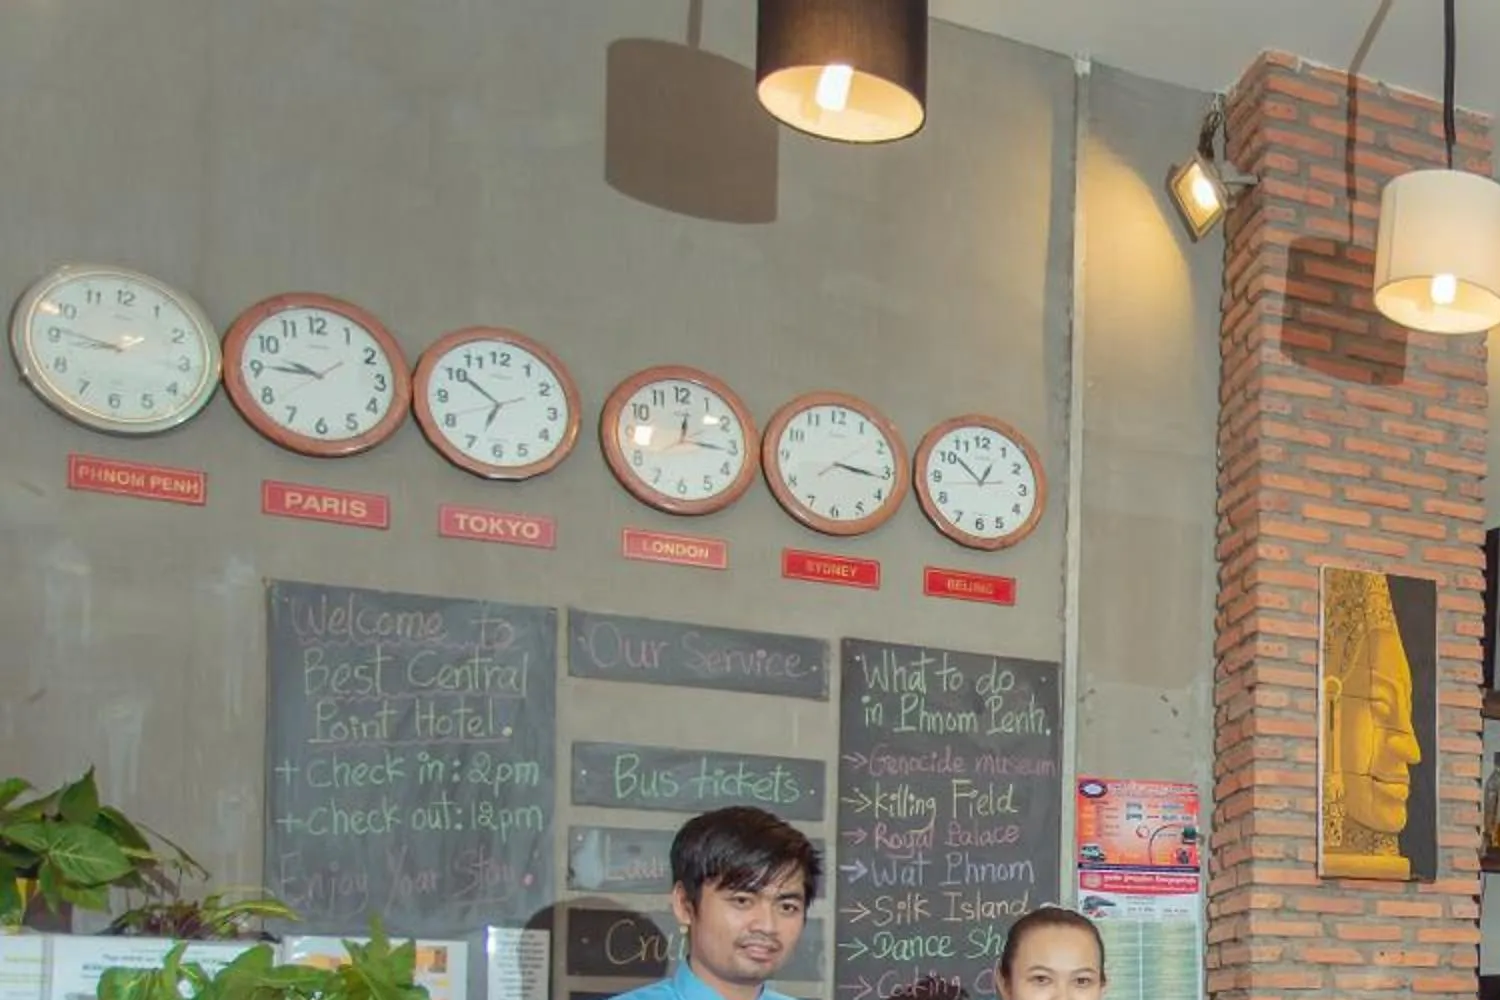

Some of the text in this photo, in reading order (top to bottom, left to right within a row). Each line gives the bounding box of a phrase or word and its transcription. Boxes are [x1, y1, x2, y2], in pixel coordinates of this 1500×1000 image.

[86, 290, 101, 304] 11
[117, 290, 136, 306] 12
[58, 303, 77, 320] 10
[48, 326, 61, 342] 9
[281, 320, 297, 338] 11
[307, 316, 327, 336] 12
[172, 328, 185, 344] 2
[259, 335, 279, 354] 10
[178, 355, 190, 372] 3
[363, 347, 376, 365] 2
[464, 354, 483, 369] 11
[490, 352, 511, 367] 12
[54, 356, 67, 373] 8
[250, 360, 263, 378] 9
[374, 373, 387, 392] 3
[446, 367, 467, 383] 10
[79, 379, 90, 395] 7
[166, 382, 178, 396] 4
[539, 382, 551, 396] 2
[674, 386, 691, 404] 12
[108, 393, 121, 408] 6
[141, 393, 154, 409] 5
[262, 386, 275, 405] 8
[437, 388, 448, 403] 9
[652, 389, 665, 407] 11
[366, 397, 378, 414] 4
[632, 403, 649, 421] 10
[286, 406, 297, 423] 7
[346, 414, 358, 430] 5
[445, 413, 456, 428] 8
[547, 407, 558, 422] 3
[807, 412, 819, 426] 11
[831, 410, 846, 425] 12
[315, 417, 328, 434] 6
[720, 415, 731, 432] 2
[465, 434, 477, 448] 7
[539, 428, 549, 441] 4
[789, 428, 804, 441] 10
[492, 443, 503, 458] 6
[517, 443, 529, 457] 5
[728, 439, 738, 456] 3
[876, 440, 885, 455] 2
[954, 438, 969, 453] 11
[974, 436, 991, 450] 12
[633, 450, 643, 466] 8
[781, 449, 790, 460] 9
[940, 451, 957, 464] 10
[653, 467, 661, 484] 7
[721, 462, 730, 476] 4
[882, 465, 890, 480] 3
[933, 469, 942, 482] 9
[1012, 463, 1021, 475] 2
[78, 465, 199, 494] PHNOM PENH
[678, 477, 687, 494] 6
[704, 475, 712, 491] 5
[788, 474, 797, 487] 8
[874, 488, 882, 501] 4
[938, 492, 948, 504] 8
[1018, 484, 1027, 497] 3
[284, 491, 368, 518] PARIS
[807, 494, 815, 507] 7
[855, 501, 864, 515] 5
[830, 505, 839, 518] 6
[954, 510, 963, 523] 7
[1012, 504, 1021, 514] 4
[455, 513, 541, 540] TOKYO
[976, 519, 984, 530] 6
[995, 517, 1004, 529] 5
[642, 539, 710, 560] LONDON
[805, 560, 858, 578] SYDNEY
[291, 593, 449, 642] Welcome
[589, 621, 808, 677] Our Service
[304, 645, 529, 697] Best Central
[860, 649, 1014, 695] What to do
[308, 699, 399, 743] Point
[861, 696, 883, 727] in
[893, 694, 979, 733] Phnom
[869, 744, 966, 777] Genocide
[614, 753, 801, 803] Bus tickets
[952, 779, 1019, 819] Field
[874, 821, 1020, 859] Royal Palace
[871, 852, 1035, 887] Wat Phnom
[281, 851, 369, 914] Enjoy
[873, 889, 1032, 927] Silk Island
[872, 931, 955, 961] Dance
